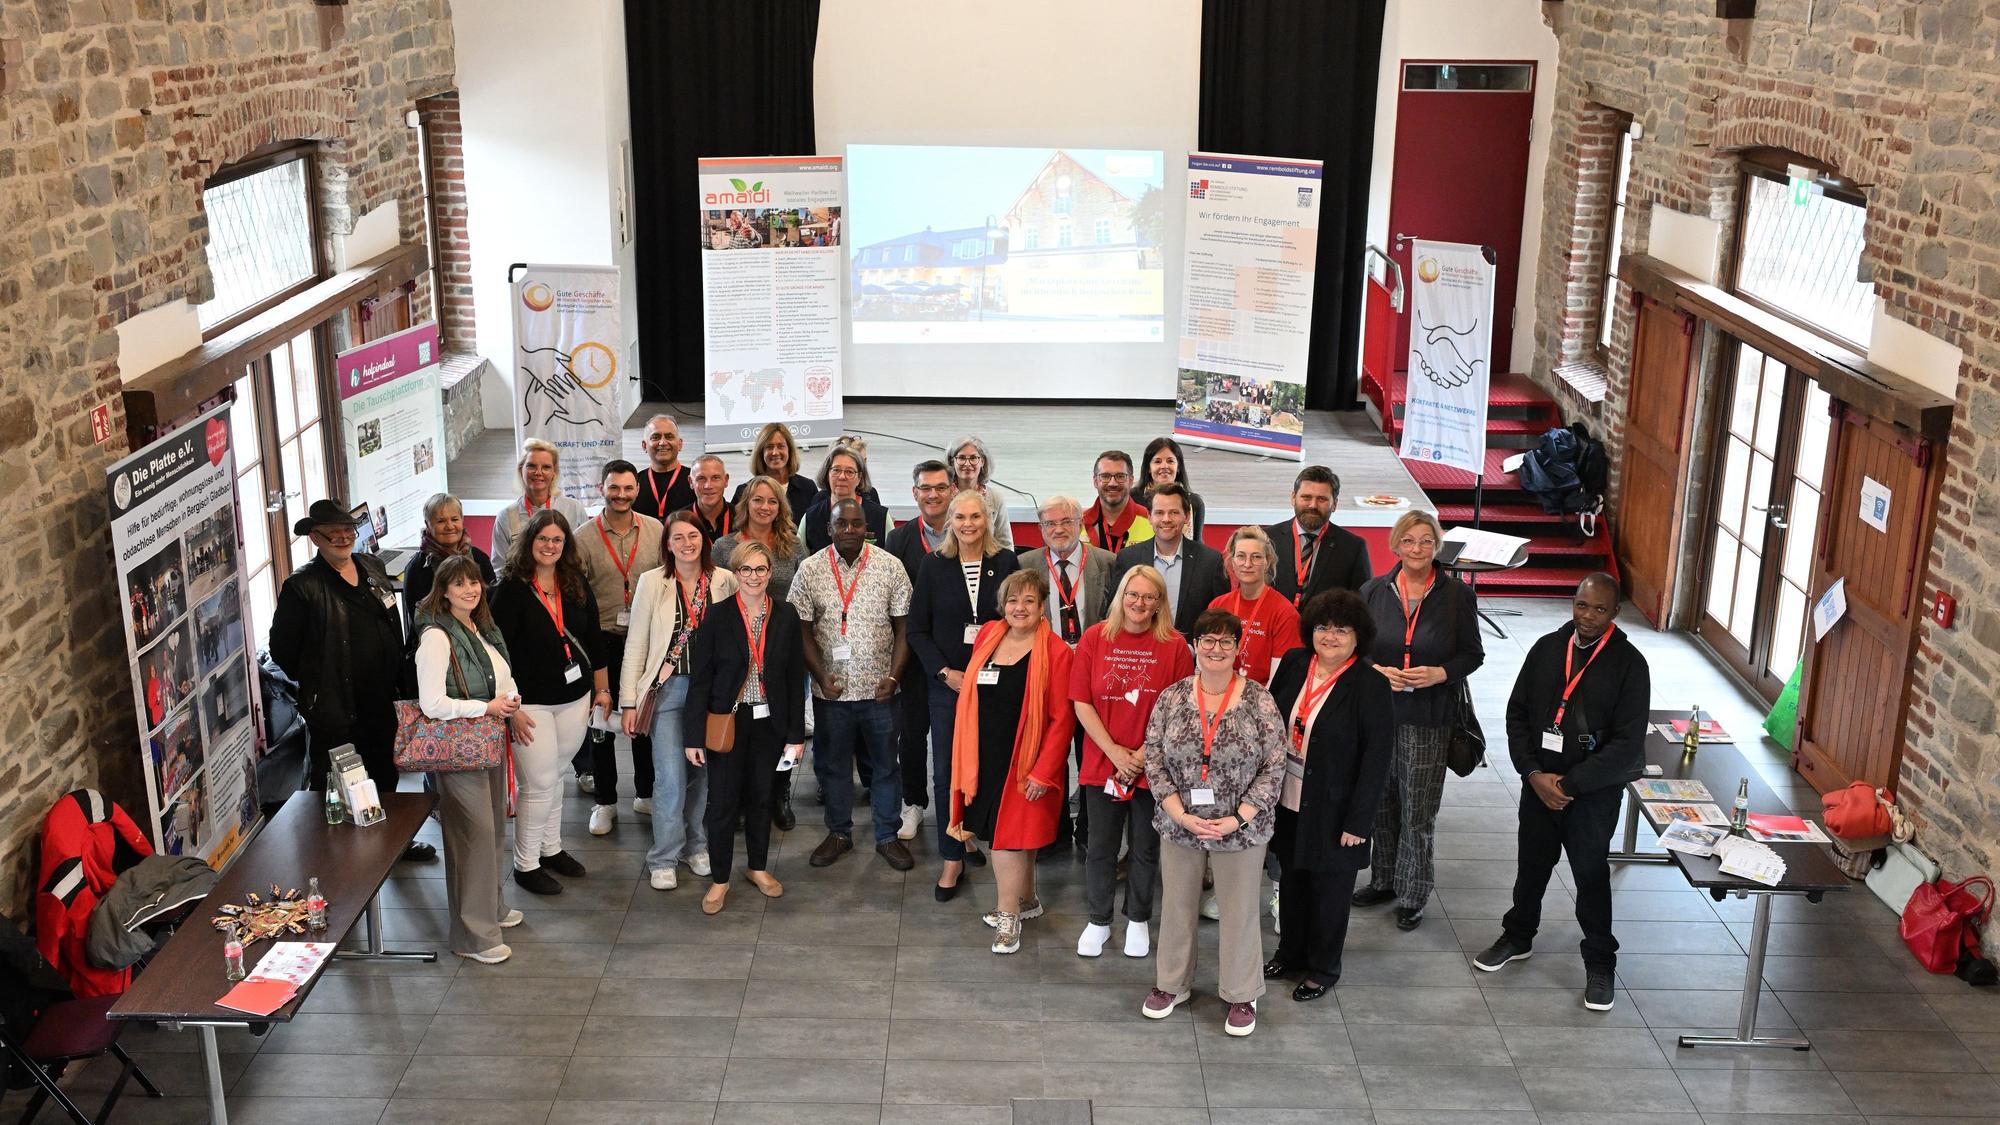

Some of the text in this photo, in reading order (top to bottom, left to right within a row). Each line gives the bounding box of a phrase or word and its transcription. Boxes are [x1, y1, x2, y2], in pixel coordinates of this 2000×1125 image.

[1256, 165, 1316, 175] www.remboldstiftung.de
[1199, 211, 1300, 227] Wir fördern Ihr Engagement
[574, 290, 605, 298] Geschäfte
[363, 353, 396, 379] helpindeal
[353, 401, 366, 413] Die
[367, 378, 424, 408] Tauschplattform
[132, 467, 149, 486] Die
[149, 451, 177, 475] Platte
[178, 439, 194, 459] e.V.
[135, 457, 195, 498] Ein wenig mehr Menschlichkeit
[126, 467, 224, 537] Hilfe für bedürftige, wohnungslose und
[122, 481, 232, 561] obdachlose Menschen in Bergisch Gladbach
[1113, 648, 1153, 656] Elterninitiative
